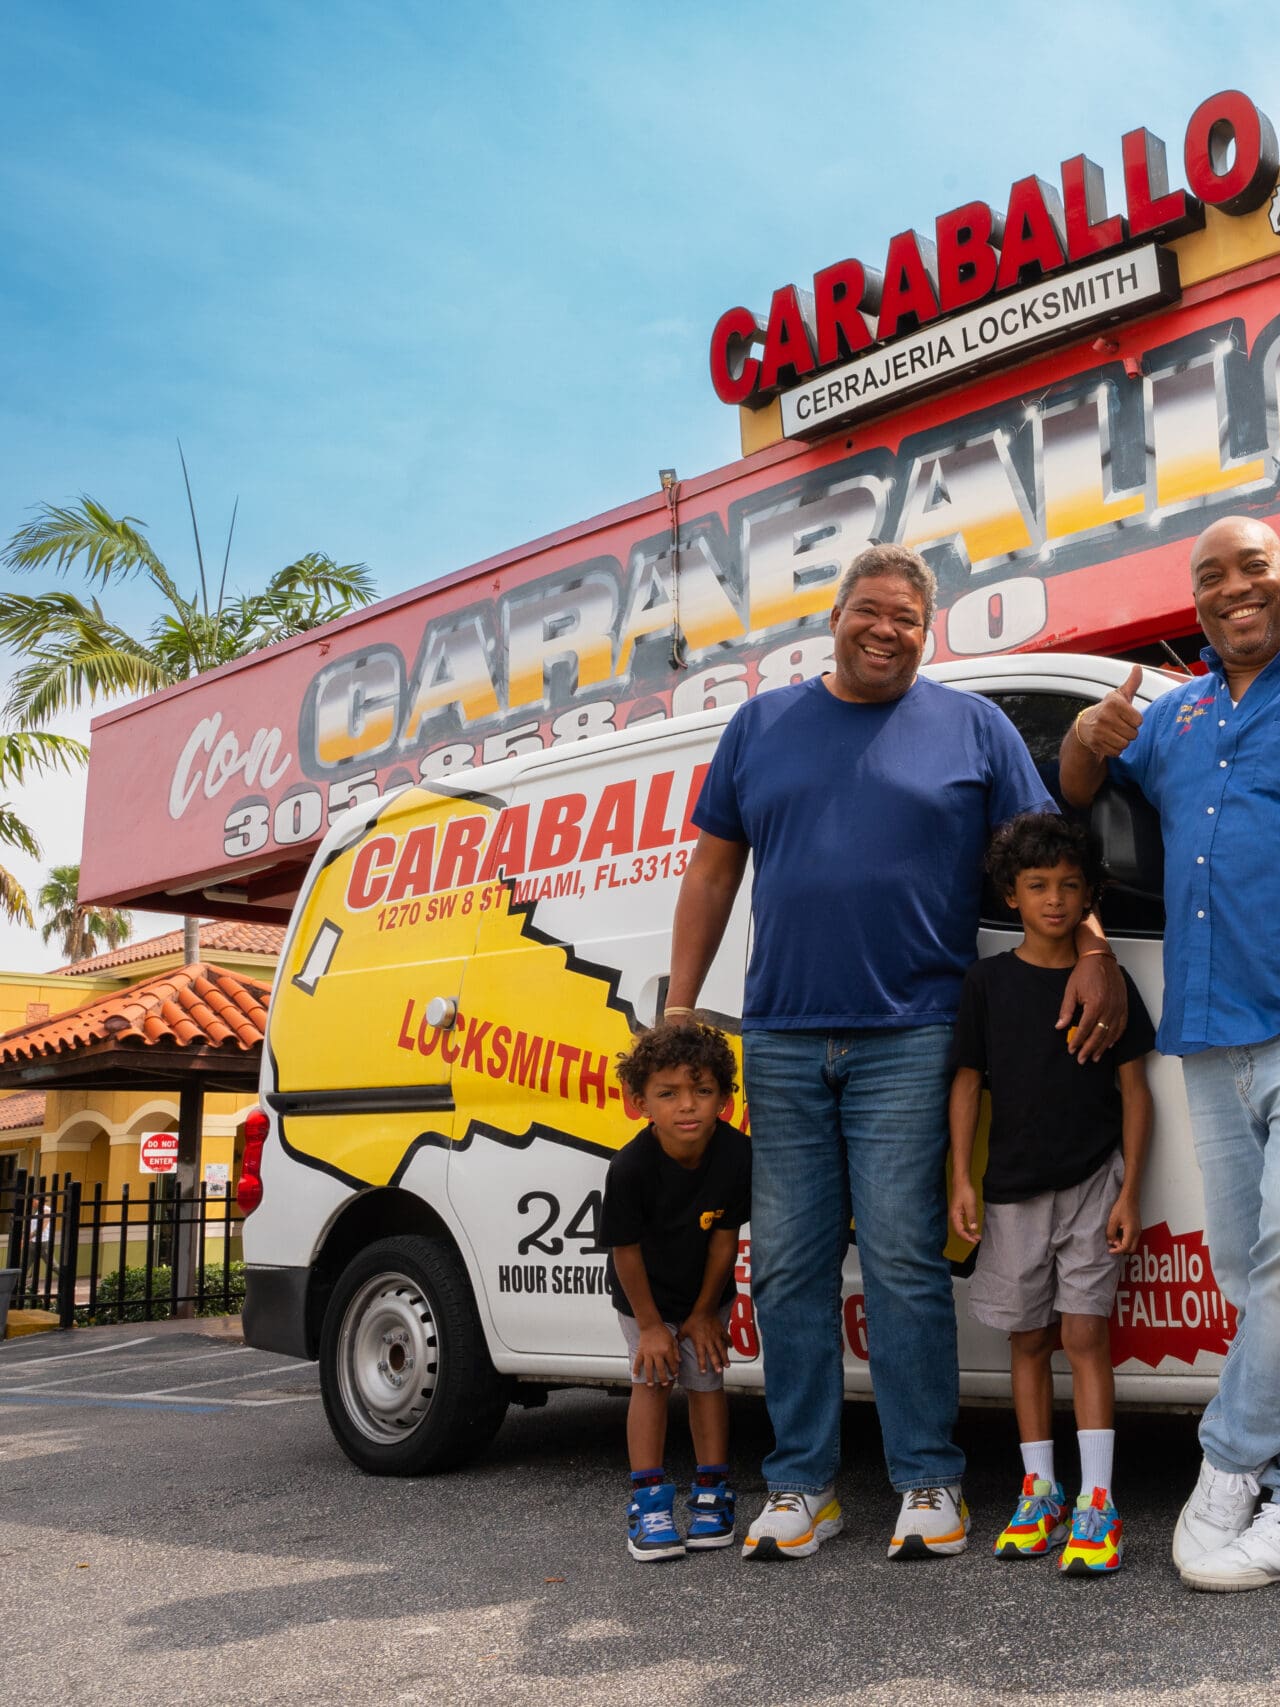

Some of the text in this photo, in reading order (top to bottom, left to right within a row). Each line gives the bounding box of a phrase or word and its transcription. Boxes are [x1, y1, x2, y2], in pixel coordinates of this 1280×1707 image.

[710, 90, 1266, 407] CARABALLO
[795, 262, 1138, 421] CERRAJERIA LOCKSMITH
[169, 711, 292, 820] Con
[377, 847, 696, 932] 1270 SW 8 ST MIAMI, FL.3313
[147, 1140, 177, 1148] DO NOT
[149, 1157, 174, 1165] ENTER
[516, 1190, 608, 1256] 24
[498, 1264, 547, 1294] HOUR
